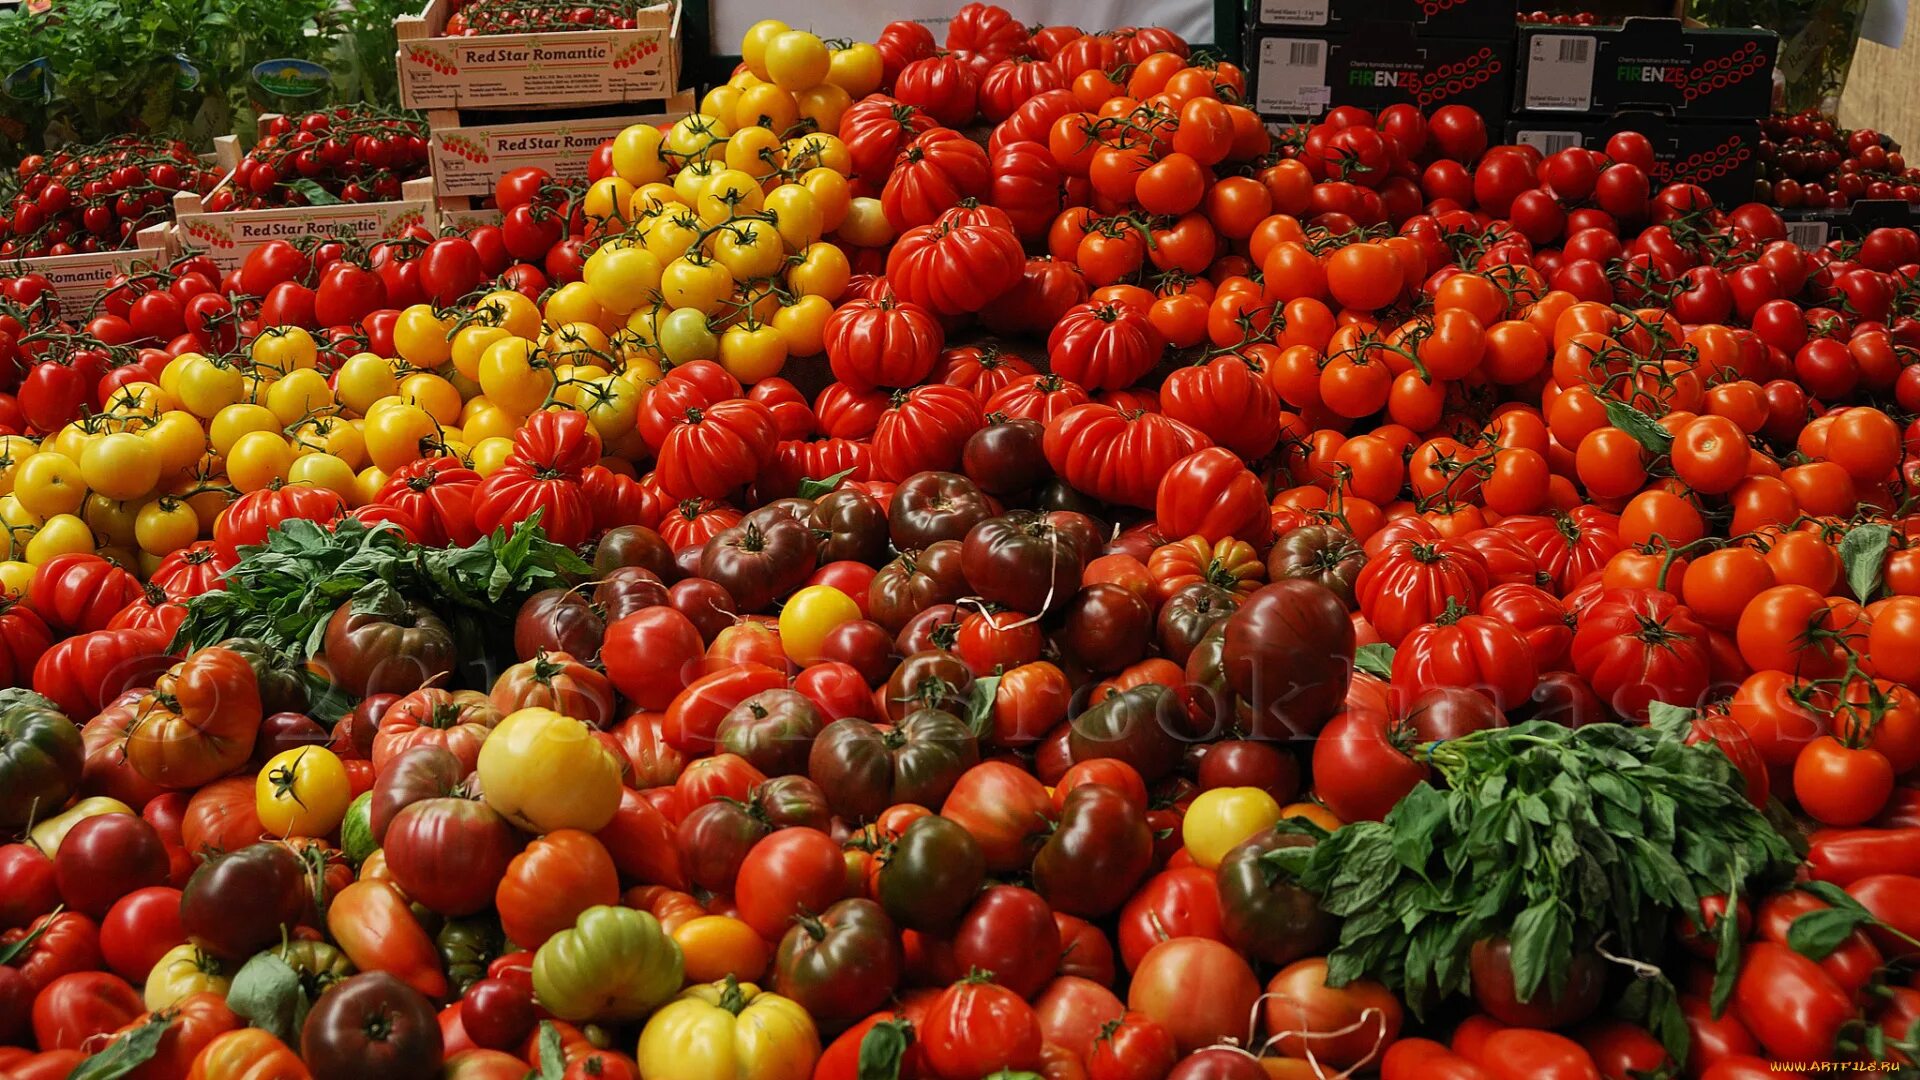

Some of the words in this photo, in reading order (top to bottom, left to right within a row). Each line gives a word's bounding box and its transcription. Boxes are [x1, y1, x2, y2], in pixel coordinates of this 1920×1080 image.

[466, 50, 495, 63] Red
[498, 48, 528, 62] Star
[533, 46, 606, 61] Romantic
[1349, 69, 1418, 88] FIRENZE
[1617, 65, 1685, 82] FIRENZE
[498, 138, 526, 151] Red
[530, 136, 560, 150] Star
[564, 135, 616, 148] Roma
[242, 224, 271, 237] Red
[274, 223, 304, 235] Star
[45, 268, 113, 284] Romantic
